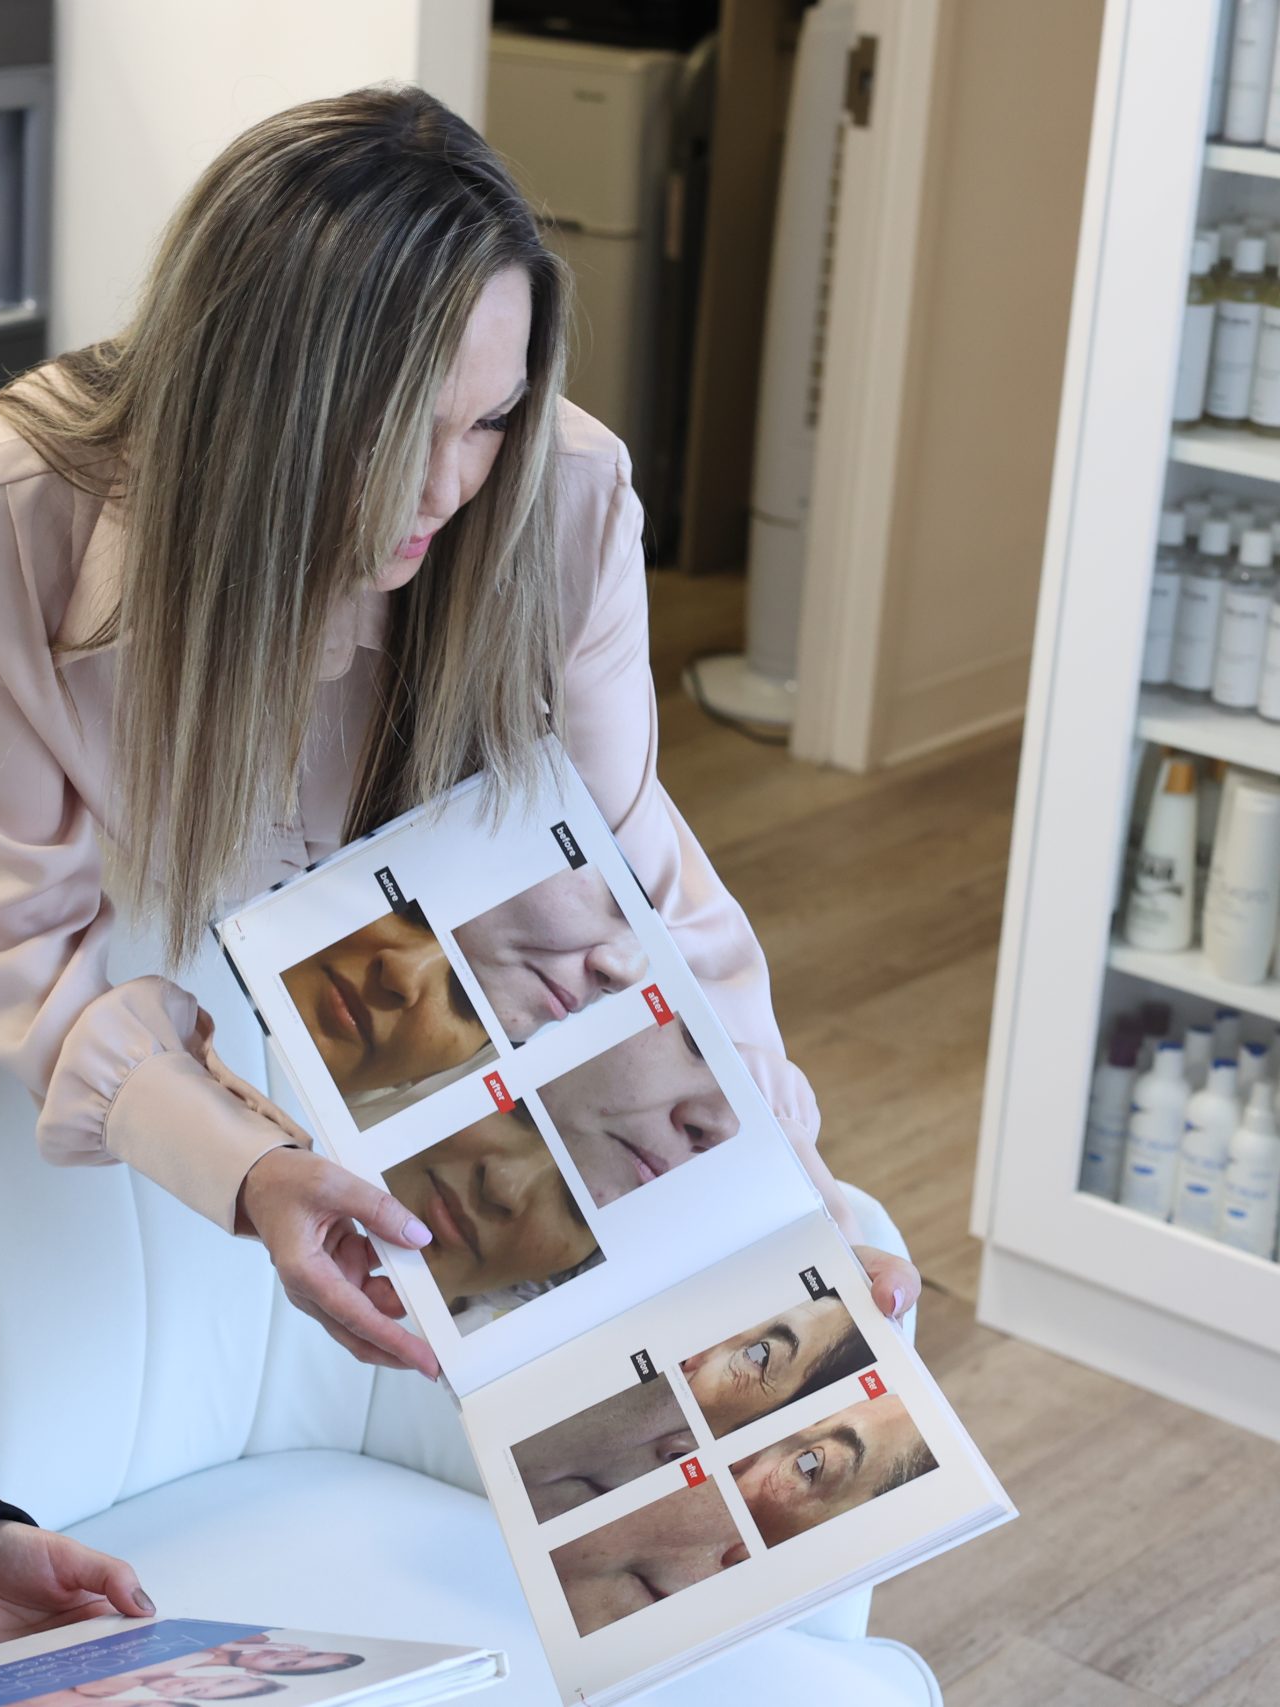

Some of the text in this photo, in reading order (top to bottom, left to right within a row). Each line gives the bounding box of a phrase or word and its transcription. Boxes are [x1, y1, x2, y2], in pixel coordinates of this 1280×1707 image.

[556, 826, 576, 857] before
[379, 871, 399, 902] before
[647, 991, 665, 1014] after
[489, 1078, 506, 1102] after
[804, 1269, 820, 1292] before
[635, 1353, 650, 1376] before
[864, 1375, 878, 1391] after
[685, 1462, 699, 1479] after
